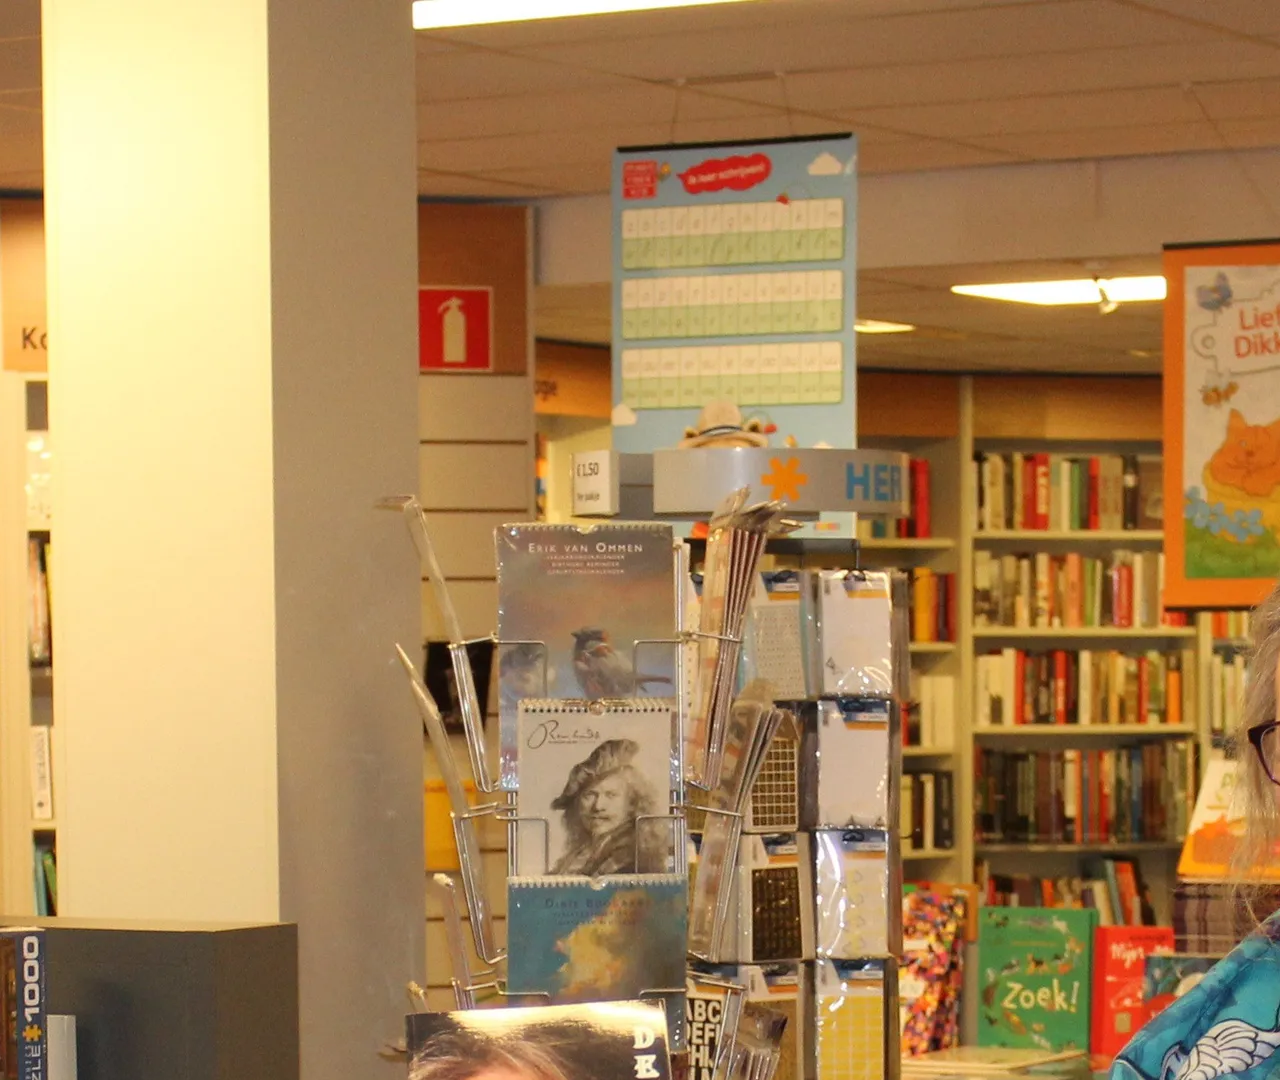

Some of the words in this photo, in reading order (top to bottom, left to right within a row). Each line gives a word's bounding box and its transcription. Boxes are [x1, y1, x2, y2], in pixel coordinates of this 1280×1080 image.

[23, 935, 40, 1023] 1000
[1001, 978, 1080, 1013] Zoek!
[632, 1026, 660, 1079] DE
